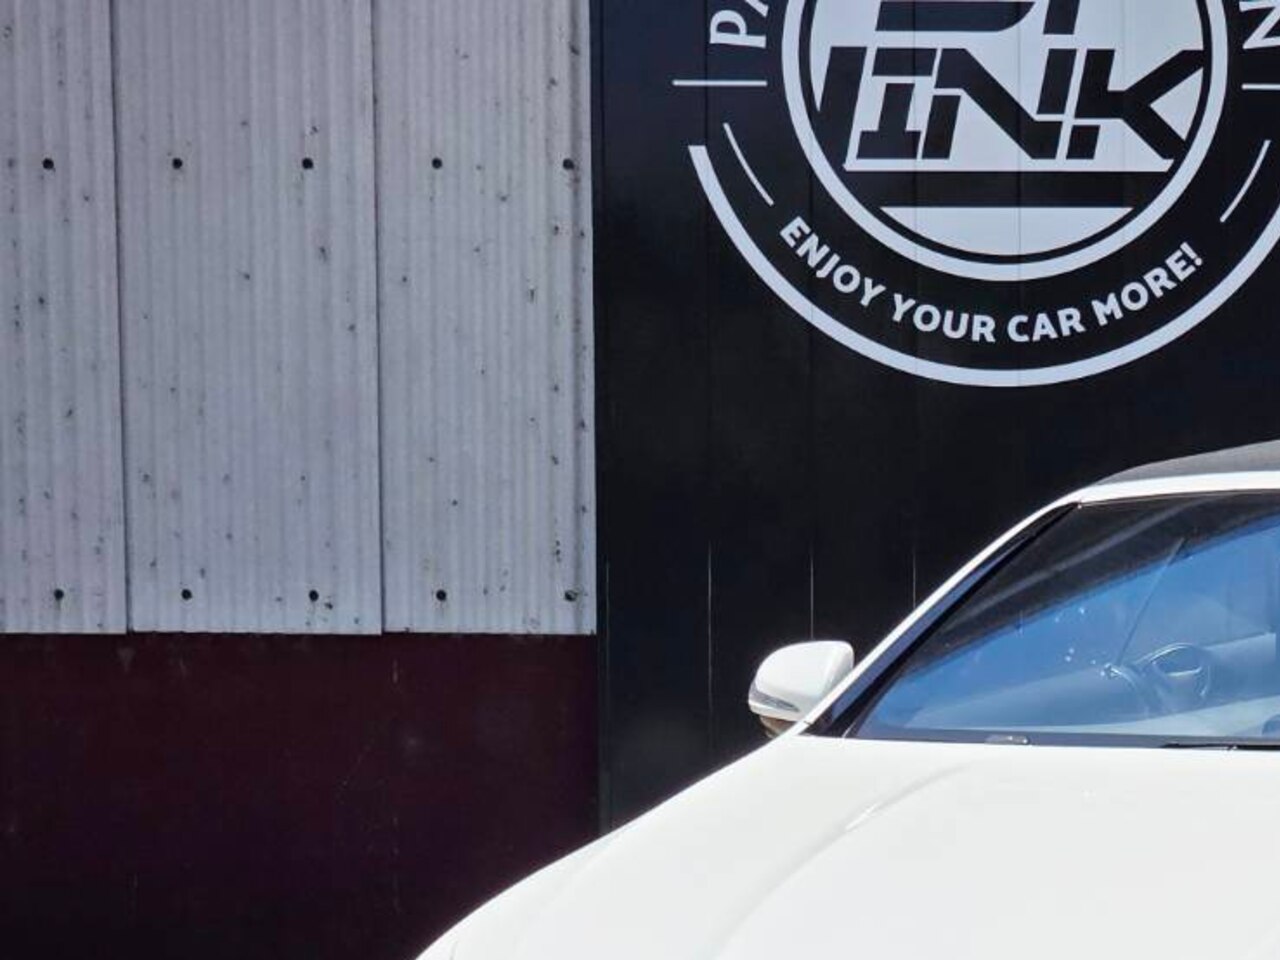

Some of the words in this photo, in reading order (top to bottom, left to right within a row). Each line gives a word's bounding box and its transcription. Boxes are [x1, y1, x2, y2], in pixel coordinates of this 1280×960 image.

[780, 216, 886, 306] ENJOY
[892, 293, 997, 343] YOUR
[1006, 307, 1086, 343] CAR
[1091, 241, 1204, 327] MORE!
